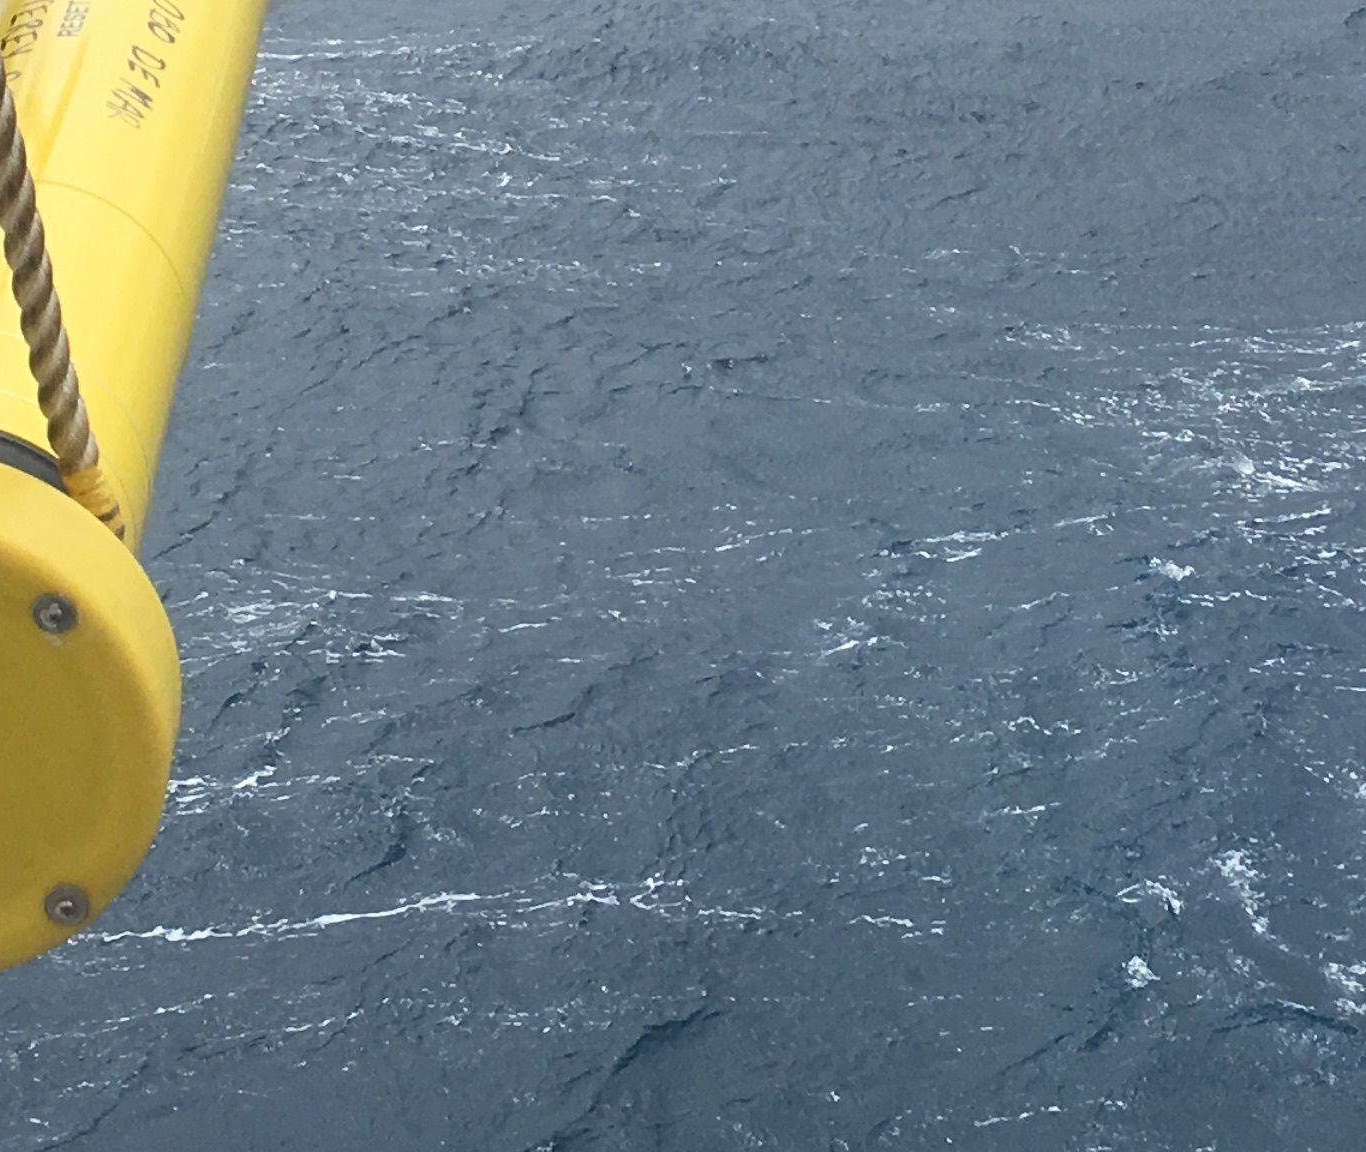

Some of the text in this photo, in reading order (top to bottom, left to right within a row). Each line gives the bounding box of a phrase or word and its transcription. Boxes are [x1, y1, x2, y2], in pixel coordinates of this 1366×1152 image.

[56, 0, 90, 39] RESET
[127, 45, 167, 89] DE
[105, 76, 154, 130] MAR
